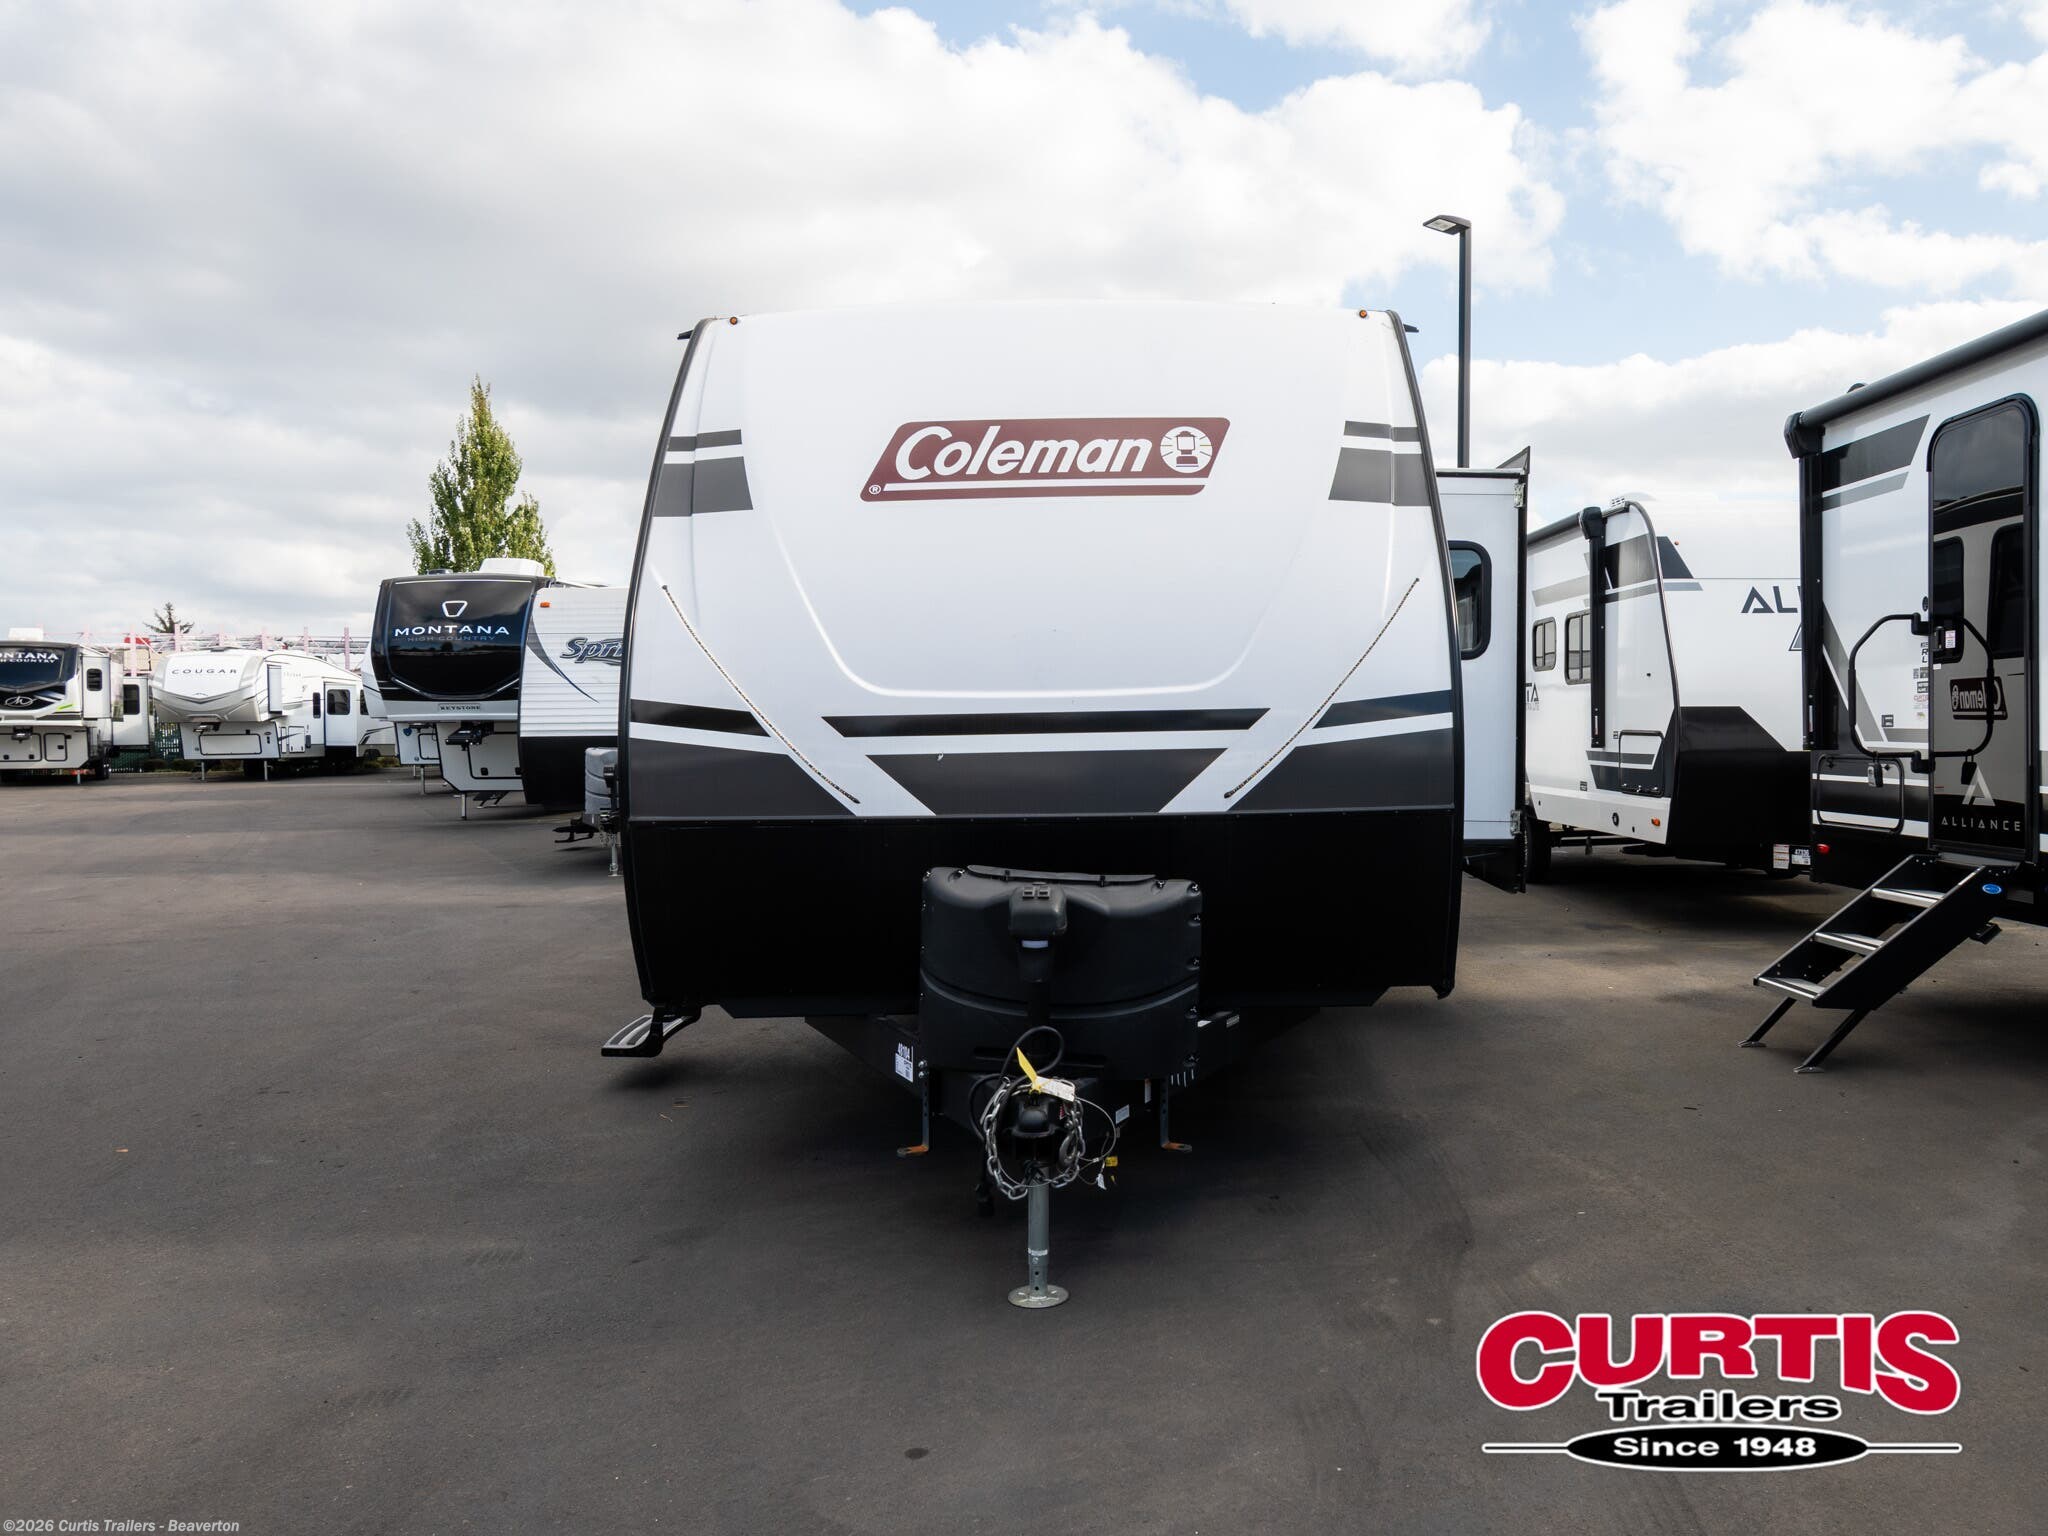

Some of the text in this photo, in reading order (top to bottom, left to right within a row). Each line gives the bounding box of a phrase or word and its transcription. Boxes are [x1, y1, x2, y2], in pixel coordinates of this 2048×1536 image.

[896, 425, 1152, 480] Coleman
[1741, 586, 1802, 613] AL
[394, 625, 510, 637] MONTANA
[1941, 816, 2021, 831] ALLIANCE
